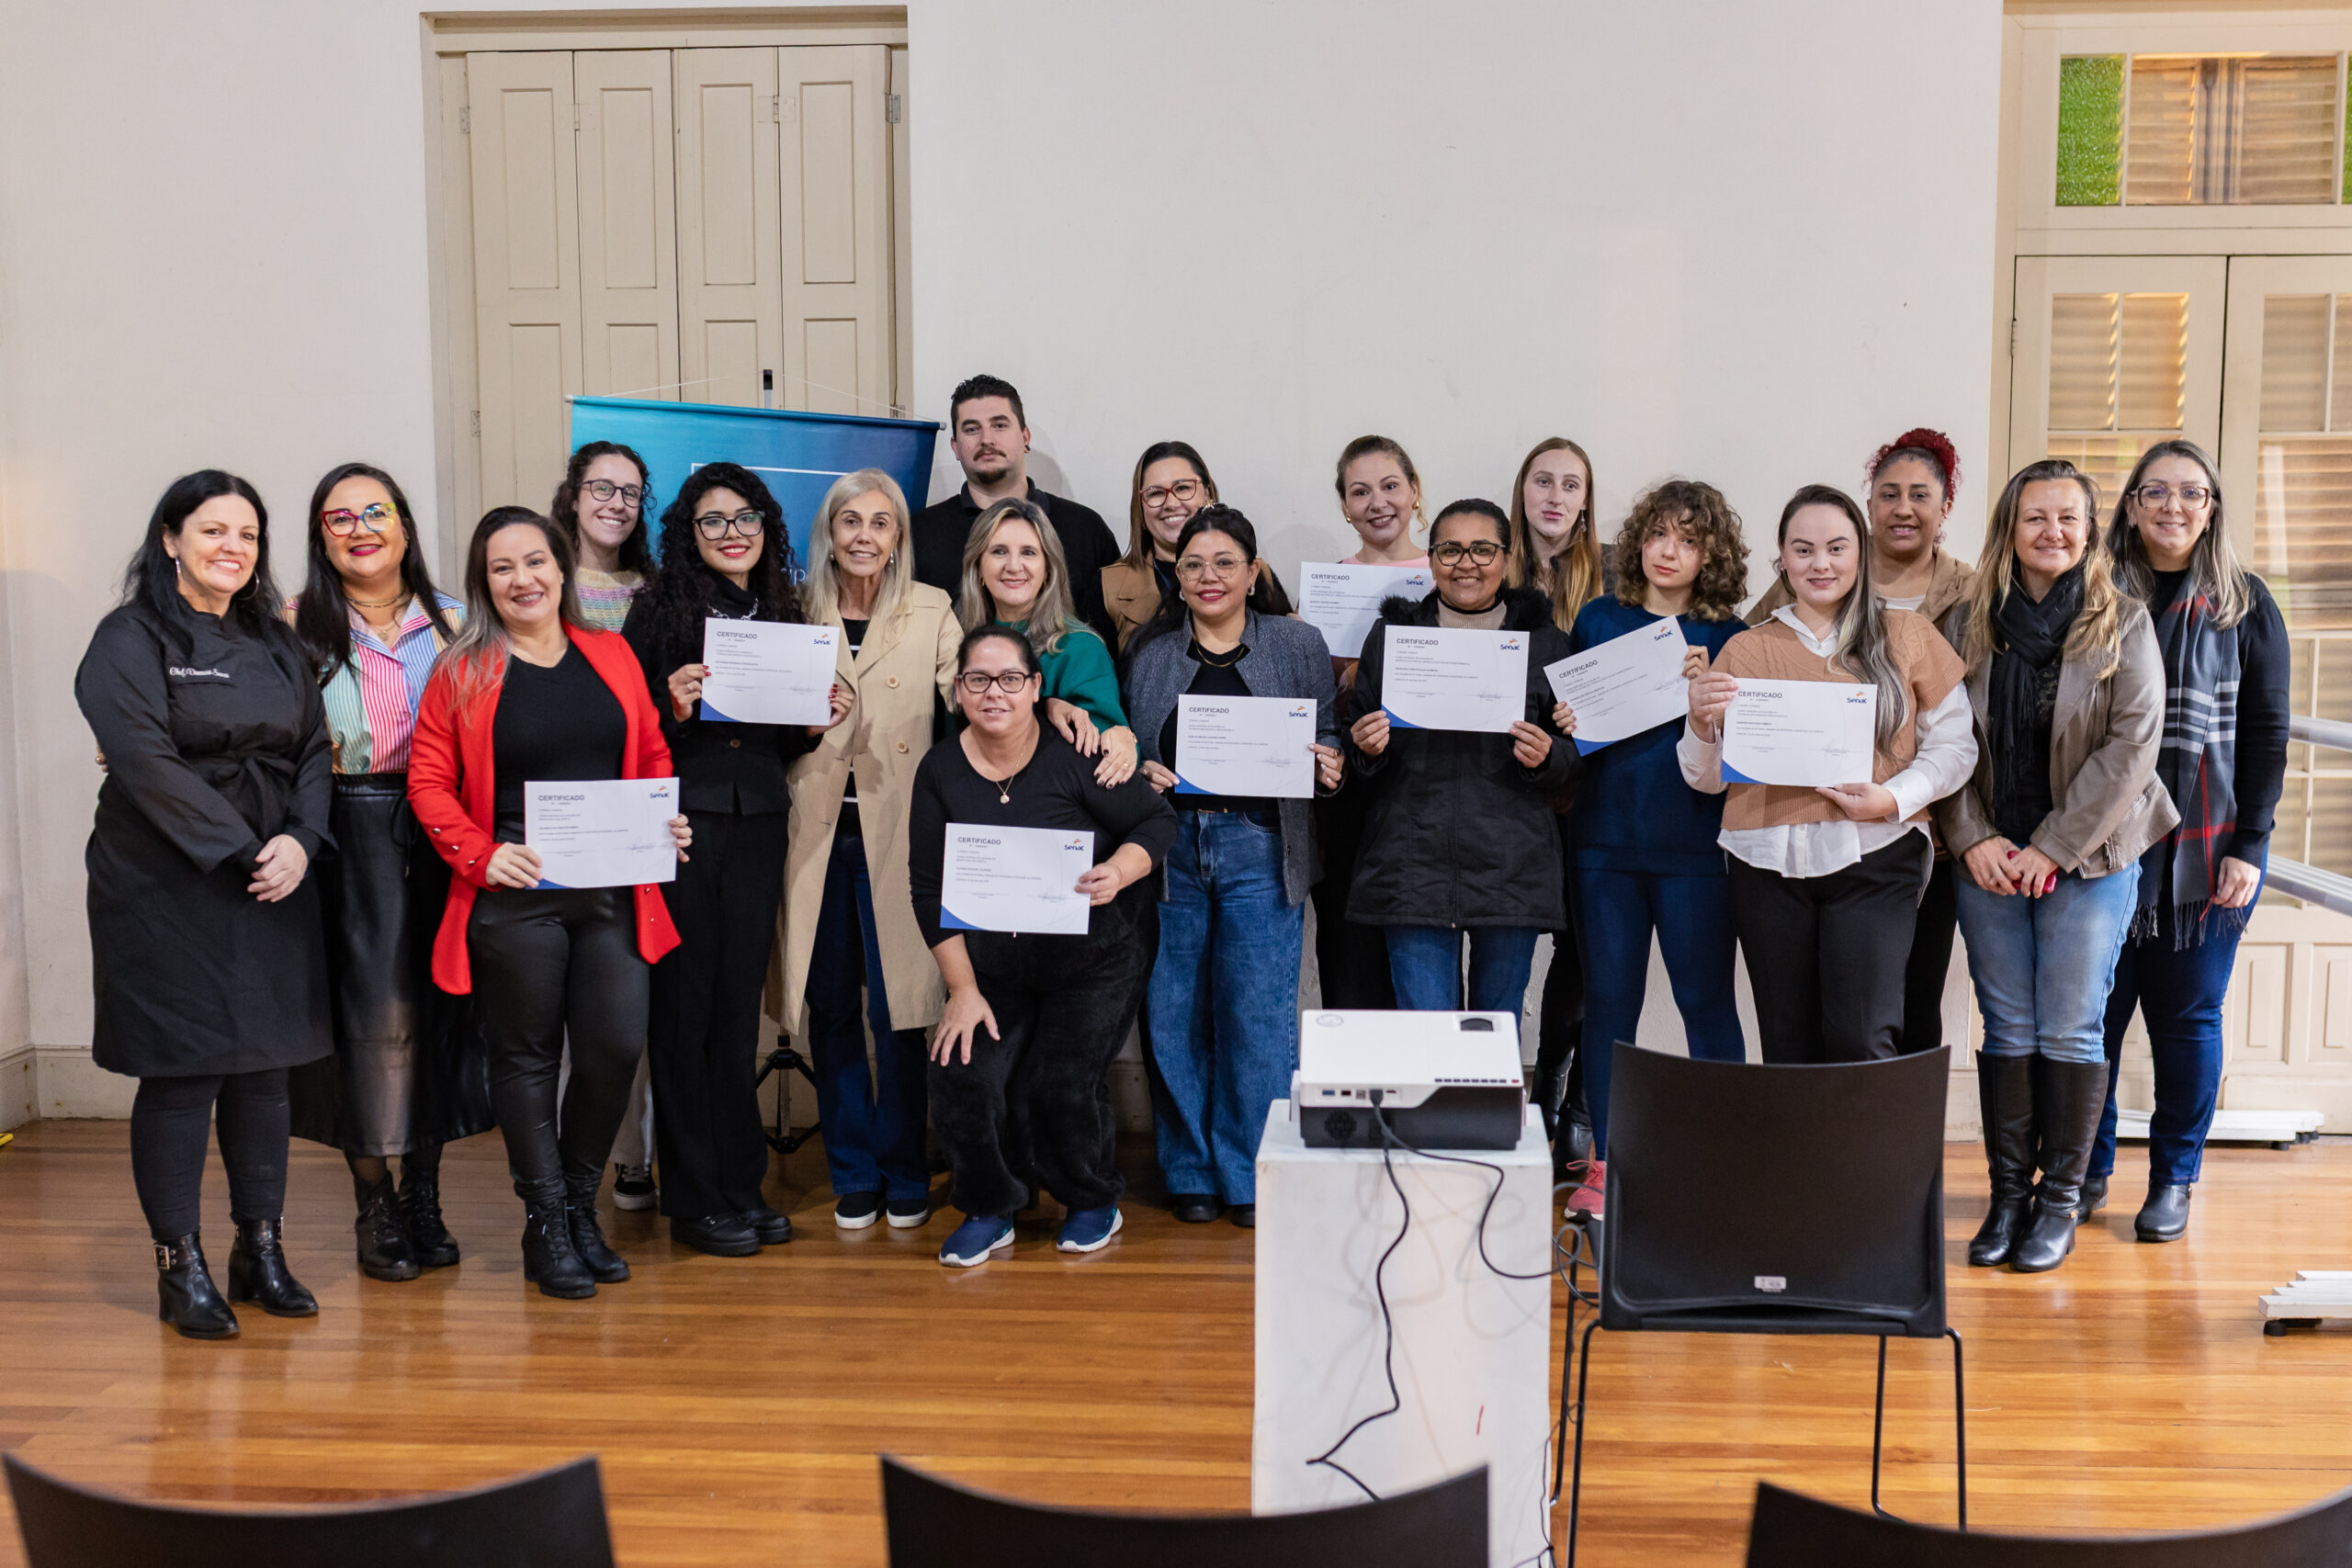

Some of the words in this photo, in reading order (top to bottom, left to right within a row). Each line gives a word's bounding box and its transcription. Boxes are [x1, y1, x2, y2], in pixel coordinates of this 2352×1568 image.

[717, 631, 758, 639] CERTIFICADO
[1396, 637, 1439, 646] CERTIFICADO
[1559, 660, 1598, 678] CERTIFICADO
[1737, 691, 1782, 699] CERTIFICADO
[957, 837, 1001, 845] CERTIFICADO
